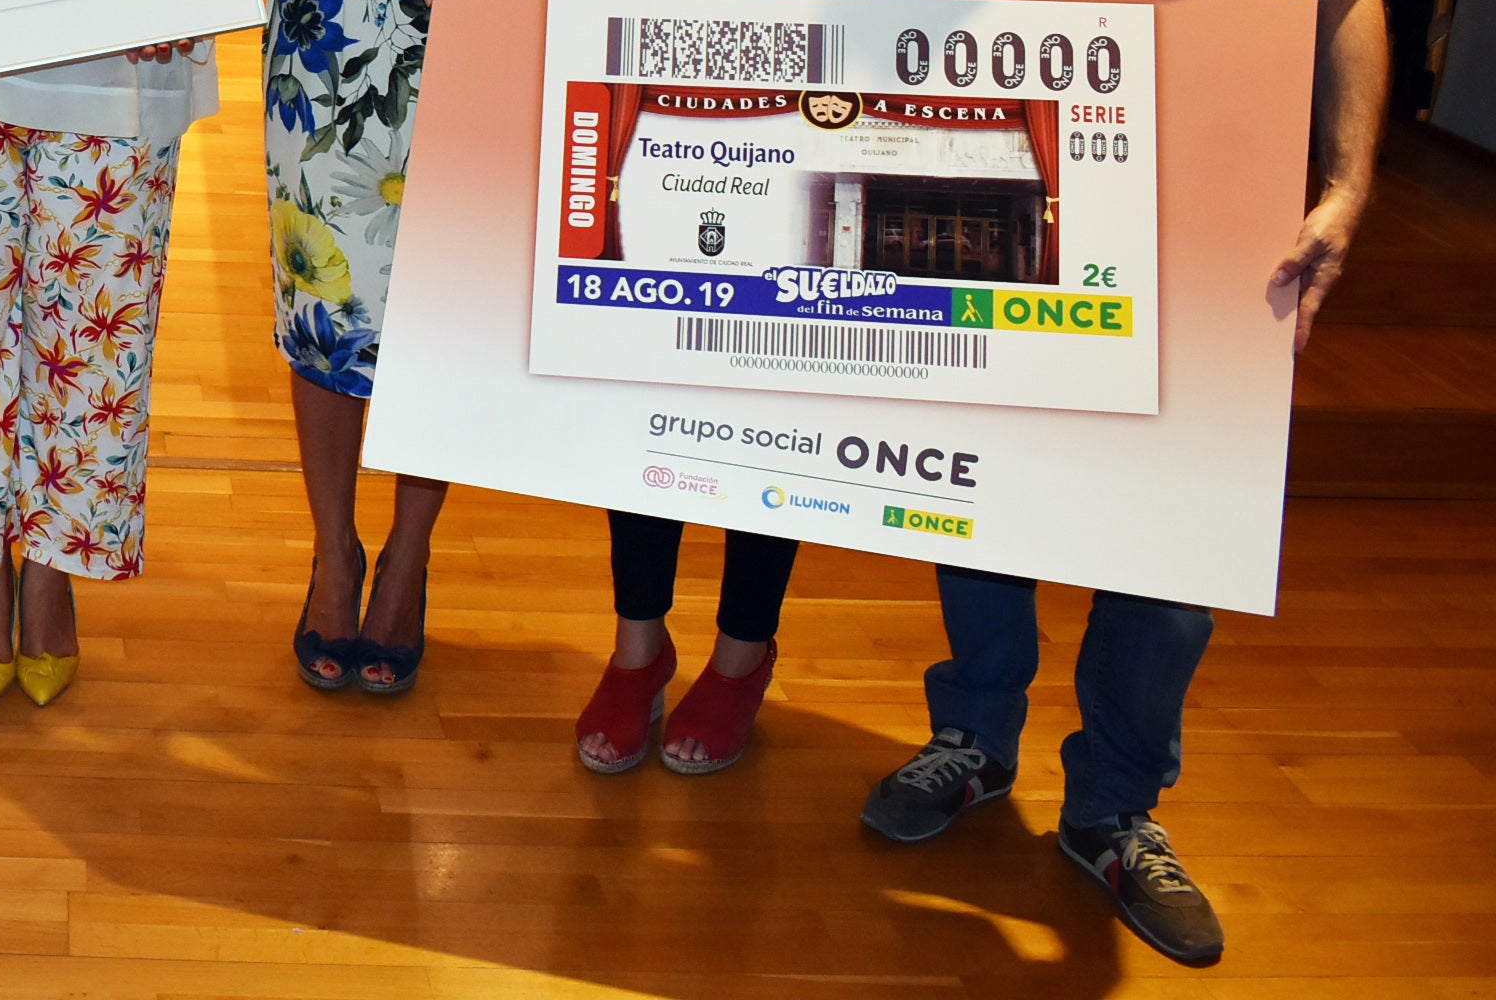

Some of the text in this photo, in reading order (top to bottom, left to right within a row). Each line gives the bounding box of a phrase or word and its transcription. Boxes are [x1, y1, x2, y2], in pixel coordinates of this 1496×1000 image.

[1098, 17, 1108, 28] R
[656, 93, 1006, 121] CIUDADES A ESCENA
[1070, 104, 1126, 124] SERIE
[877, 136, 920, 144] MUNICIPAL
[638, 137, 795, 168] Teatro Quijano
[861, 149, 898, 157] QUIJANO
[567, 111, 599, 229] DOMINGO
[661, 173, 770, 197] Ciudad Real
[764, 270, 776, 281] el
[1082, 264, 1118, 288] 2€
[566, 273, 735, 308] 18 AGO. 19
[797, 300, 944, 322] del fin de semana
[1003, 296, 1124, 331] ONCE
[648, 413, 980, 488] grupo social ONCE
[677, 480, 718, 496] ONCE
[678, 471, 719, 485] Fundación
[789, 494, 850, 515] ILUNION
[908, 513, 969, 536] ONCE
